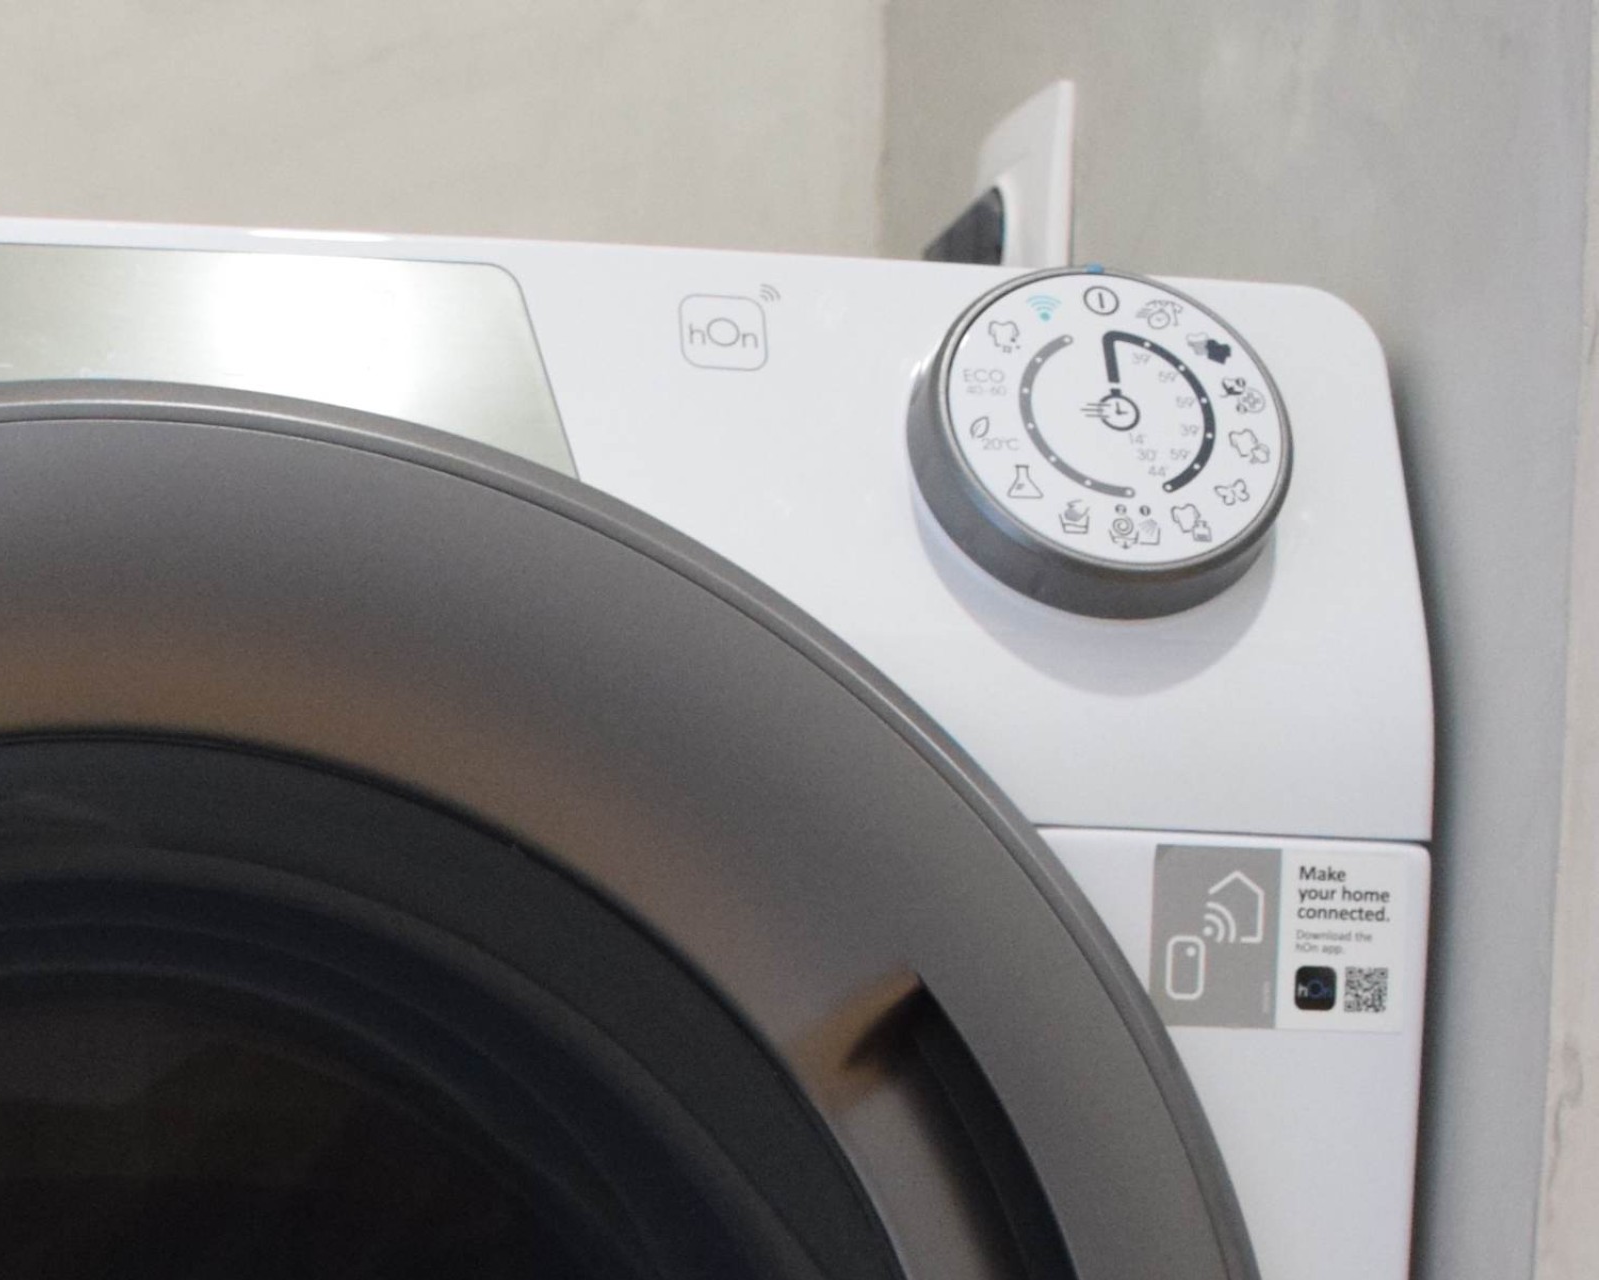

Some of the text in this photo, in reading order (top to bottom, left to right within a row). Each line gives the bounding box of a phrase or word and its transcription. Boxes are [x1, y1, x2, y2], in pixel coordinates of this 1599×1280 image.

[689, 317, 759, 348] hOn
[963, 369, 1005, 383] ECO
[1299, 866, 1346, 882] Make
[1298, 887, 1390, 902] your home
[1297, 906, 1391, 923] connected.
[1296, 929, 1373, 942] Download the
